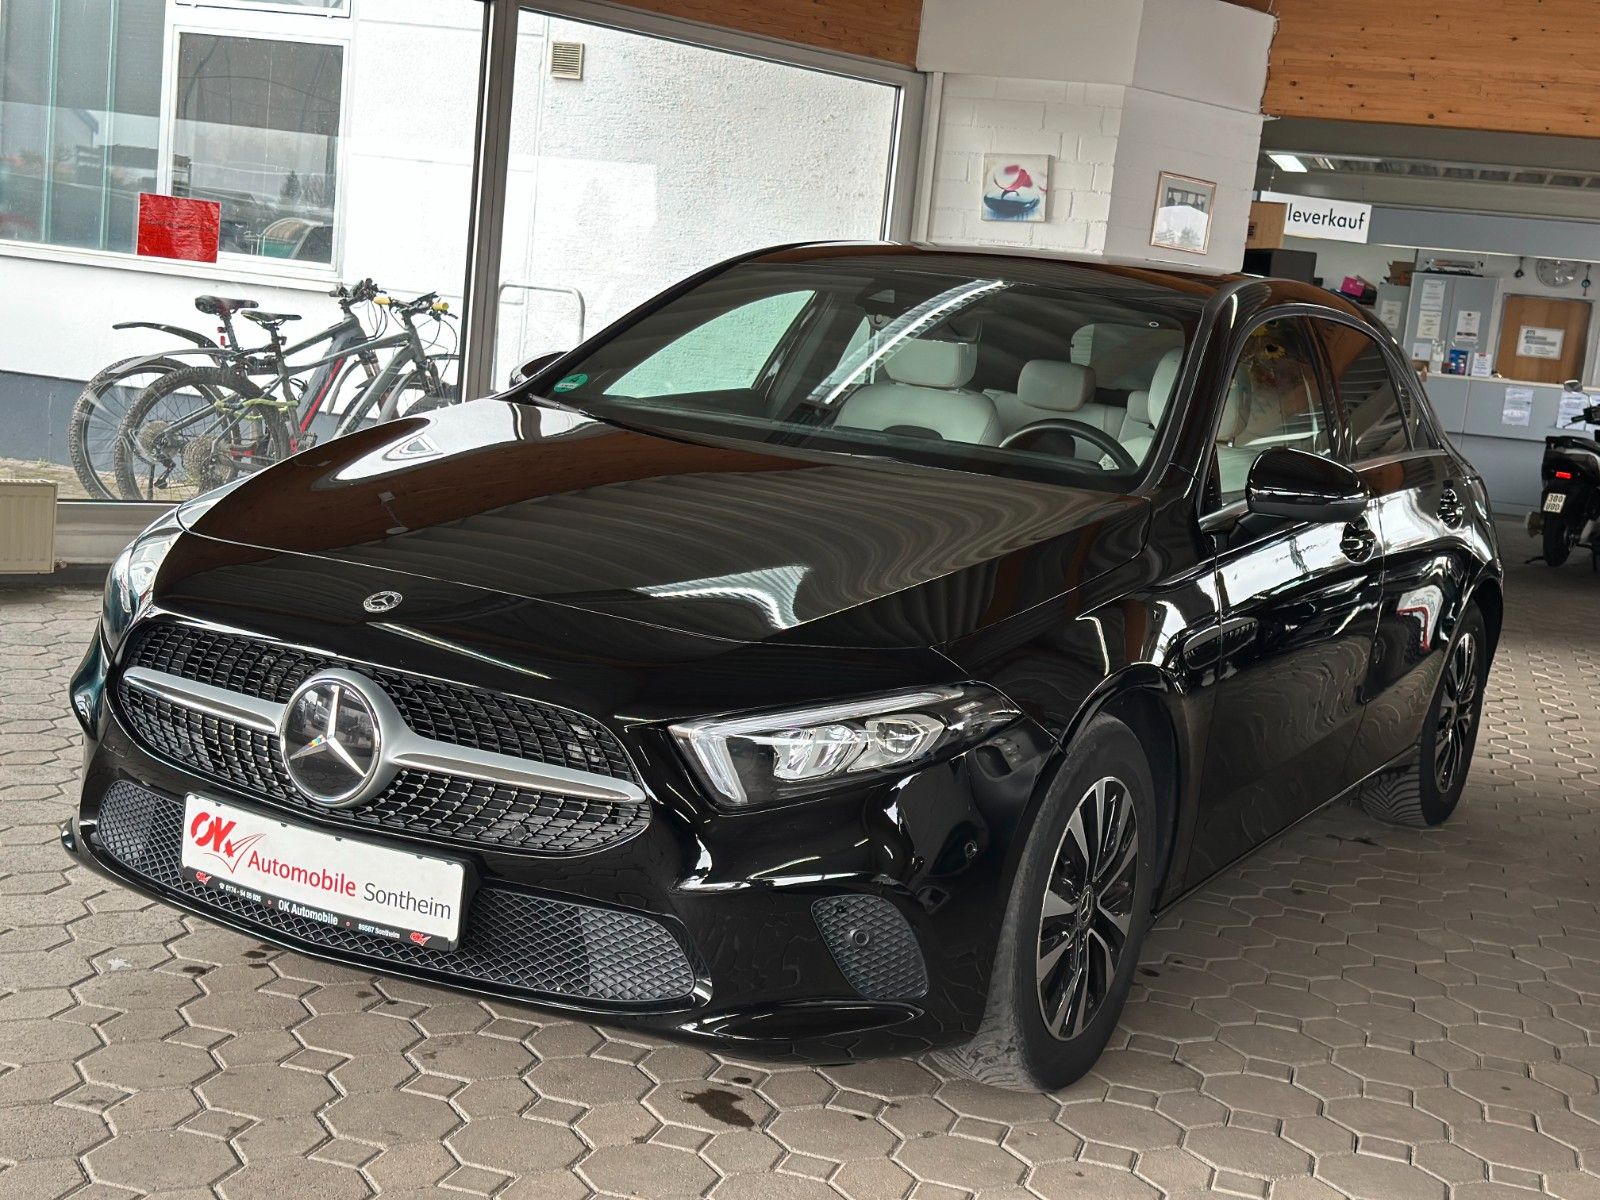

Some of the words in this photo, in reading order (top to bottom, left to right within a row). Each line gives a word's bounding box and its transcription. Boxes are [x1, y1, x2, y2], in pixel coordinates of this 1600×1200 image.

[1287, 203, 1366, 230] leverkauf
[247, 850, 356, 897] Automobile
[363, 882, 451, 920] Sontheim
[278, 899, 291, 913] OK
[291, 903, 339, 926] Automobile
